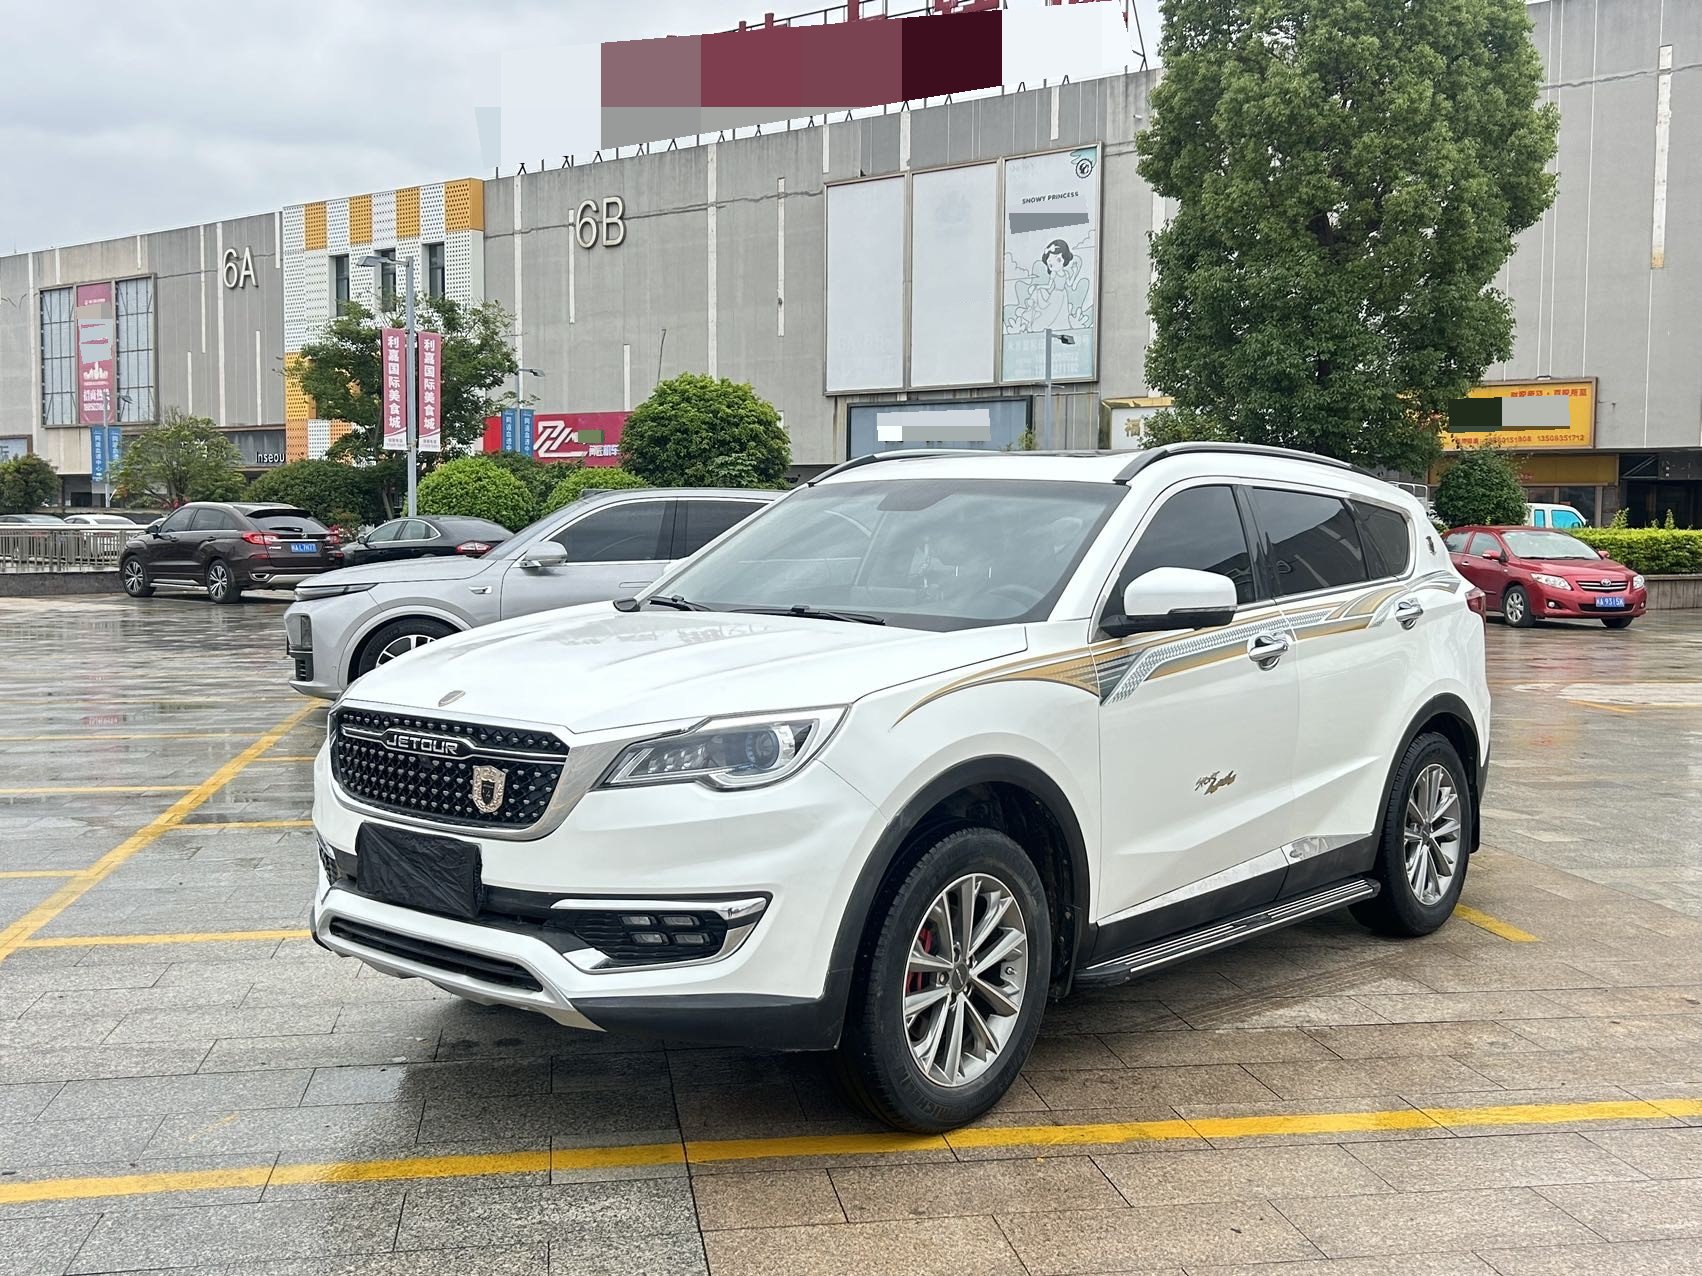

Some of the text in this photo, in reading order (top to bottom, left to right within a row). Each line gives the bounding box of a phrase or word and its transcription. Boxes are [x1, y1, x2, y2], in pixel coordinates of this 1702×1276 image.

[1021, 191, 1080, 205] SNOWY PRINCESS
[575, 196, 625, 249] 6B
[223, 246, 258, 289] 6A
[387, 335, 401, 429] 利嘉国际美食城
[423, 338, 436, 430] 利嘉国际美食城
[386, 734, 459, 756] JETOUR
